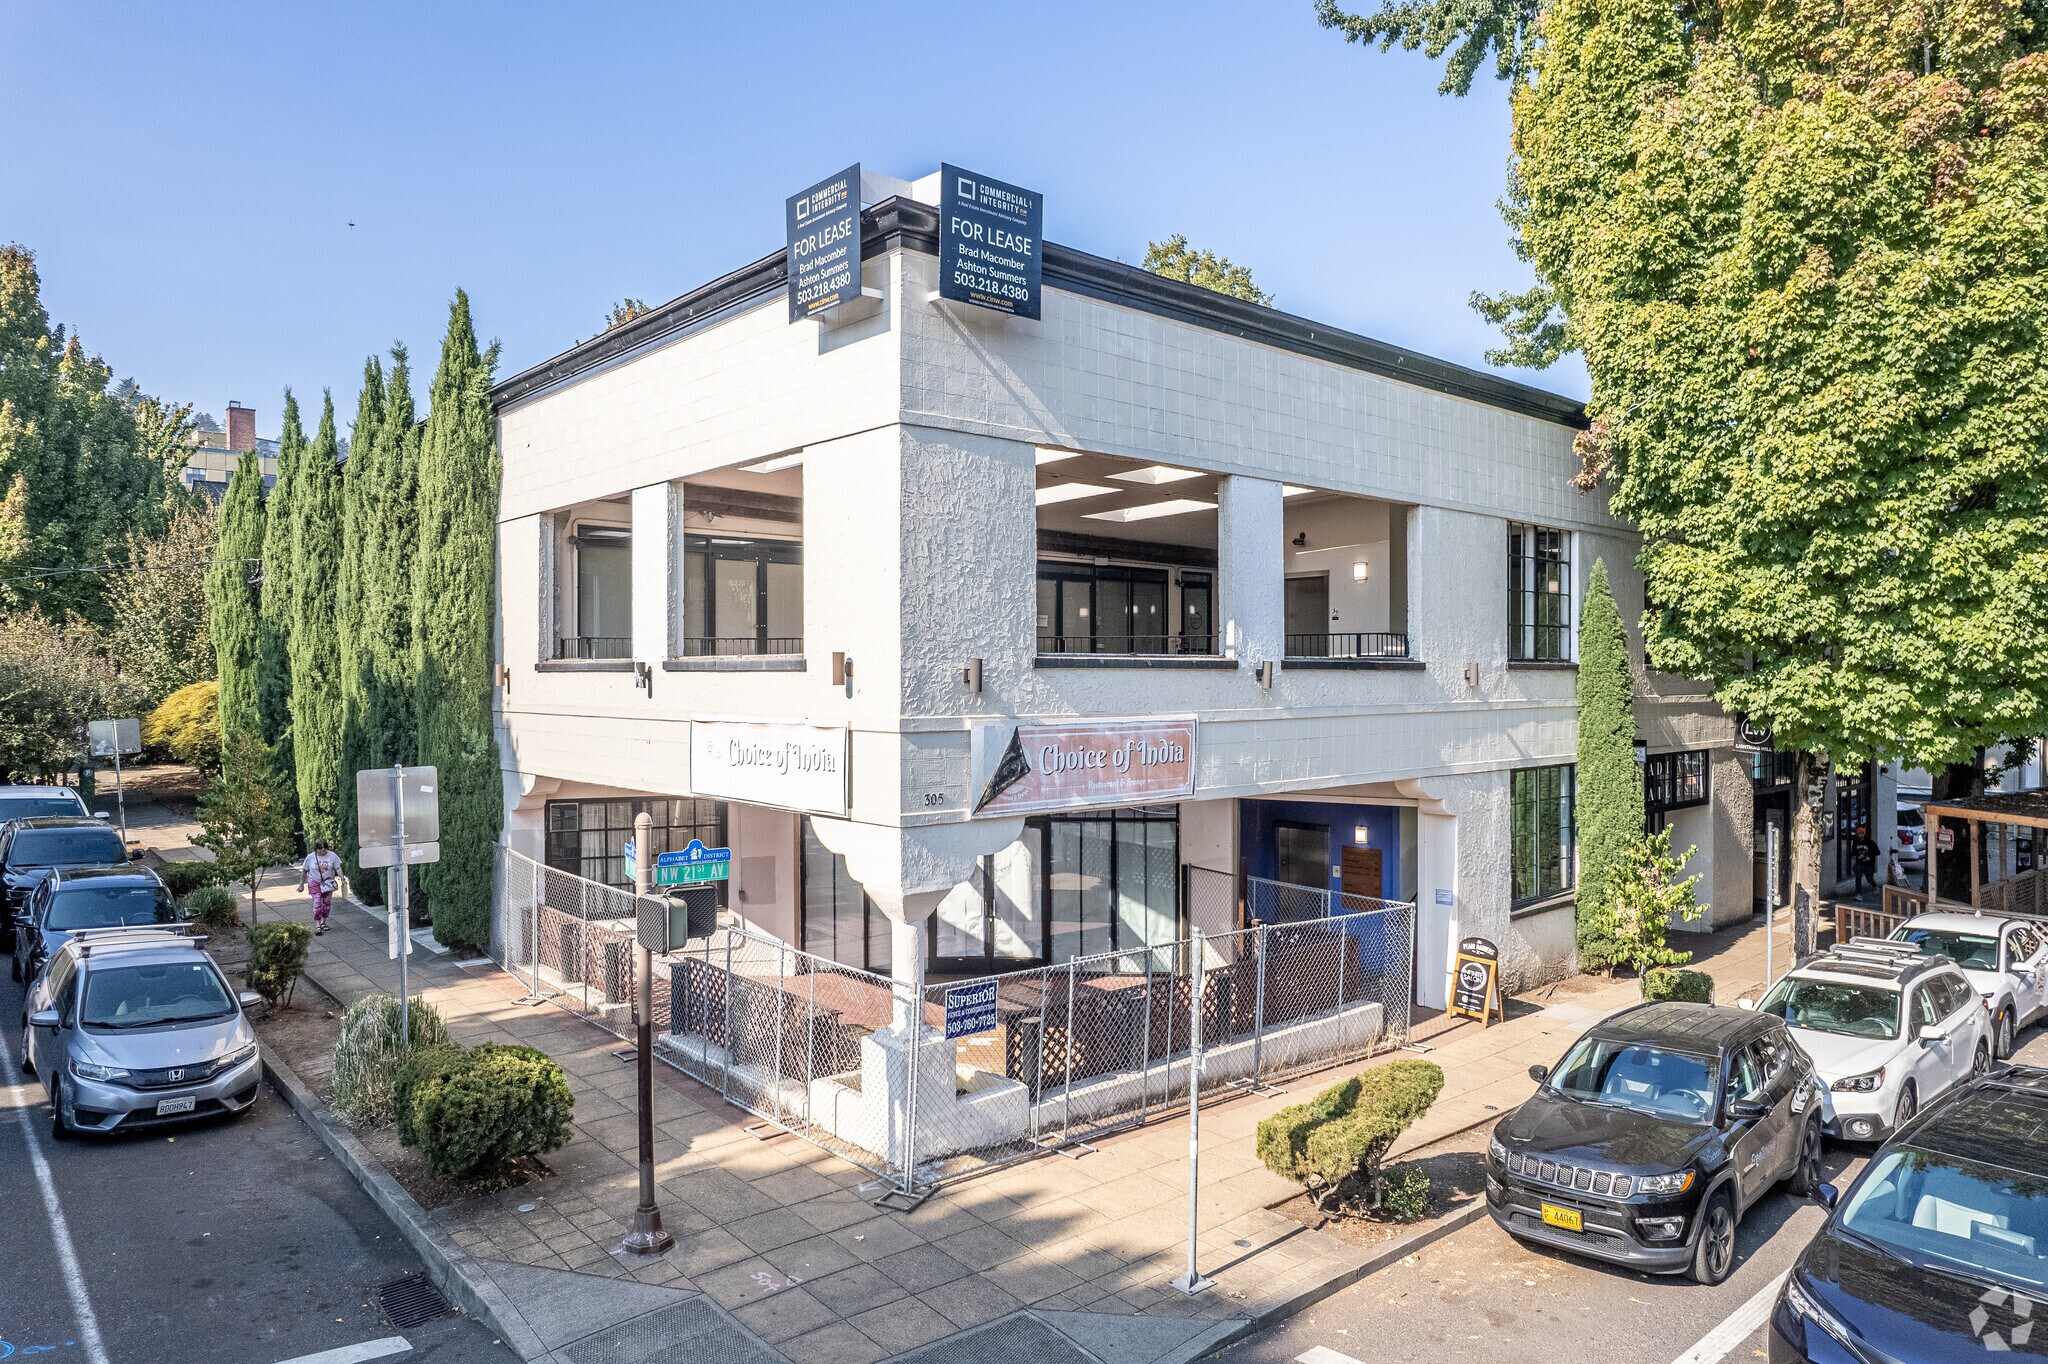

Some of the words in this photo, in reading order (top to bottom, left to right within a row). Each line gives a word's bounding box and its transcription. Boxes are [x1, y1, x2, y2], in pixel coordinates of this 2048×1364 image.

[812, 179, 847, 204] COMMERCIAL
[980, 184, 1028, 208] COMMERCIAL
[812, 192, 841, 213] INTEGRITY
[980, 195, 1019, 214] INTEGRITY
[979, 206, 998, 216] Investment
[998, 212, 1012, 221] Advisory
[1012, 216, 1027, 226] Company
[794, 235, 816, 259] FOR
[819, 217, 852, 248] LEASE
[952, 216, 983, 242] FOR
[988, 227, 1032, 256] LEASE
[800, 259, 813, 274] Brad
[814, 247, 847, 268] Macomber
[959, 243, 979, 258] Brad
[980, 250, 1025, 271] Macomber
[799, 273, 820, 289] Ashton
[820, 261, 848, 279] Summers
[957, 258, 987, 275] Ashton
[989, 266, 1027, 285] Summers
[797, 271, 851, 305] 503.218.4380
[954, 271, 1029, 301] 503.218.4380
[808, 293, 839, 310] www.cinw.com
[970, 292, 1014, 307] www.cinw.com
[1038, 744, 1107, 775] Choice
[1112, 741, 1136, 774] of
[1137, 739, 1185, 767] India
[1735, 743, 1761, 751] LIGHTNING
[729, 739, 773, 766] Choice
[776, 742, 793, 776] of
[793, 744, 836, 773] India
[1087, 780, 1119, 791] Restaurant
[1648, 785, 1671, 801] AIL
[924, 793, 945, 806] 305
[660, 855, 688, 863] ALPHABET
[704, 851, 729, 859] DISTRICT
[661, 867, 678, 882] NW
[684, 864, 704, 880] 21ST
[711, 863, 724, 877] AV
[1476, 944, 1495, 956] BARBERS
[1463, 974, 1483, 983] SALON
[948, 986, 995, 1009] SUPERIOR
[948, 1011, 961, 1019] FENCE
[965, 1003, 995, 1015] CONSTRUCTION
[947, 1014, 995, 1034] 503-760-7725
[1554, 1211, 1579, 1226] 44067
